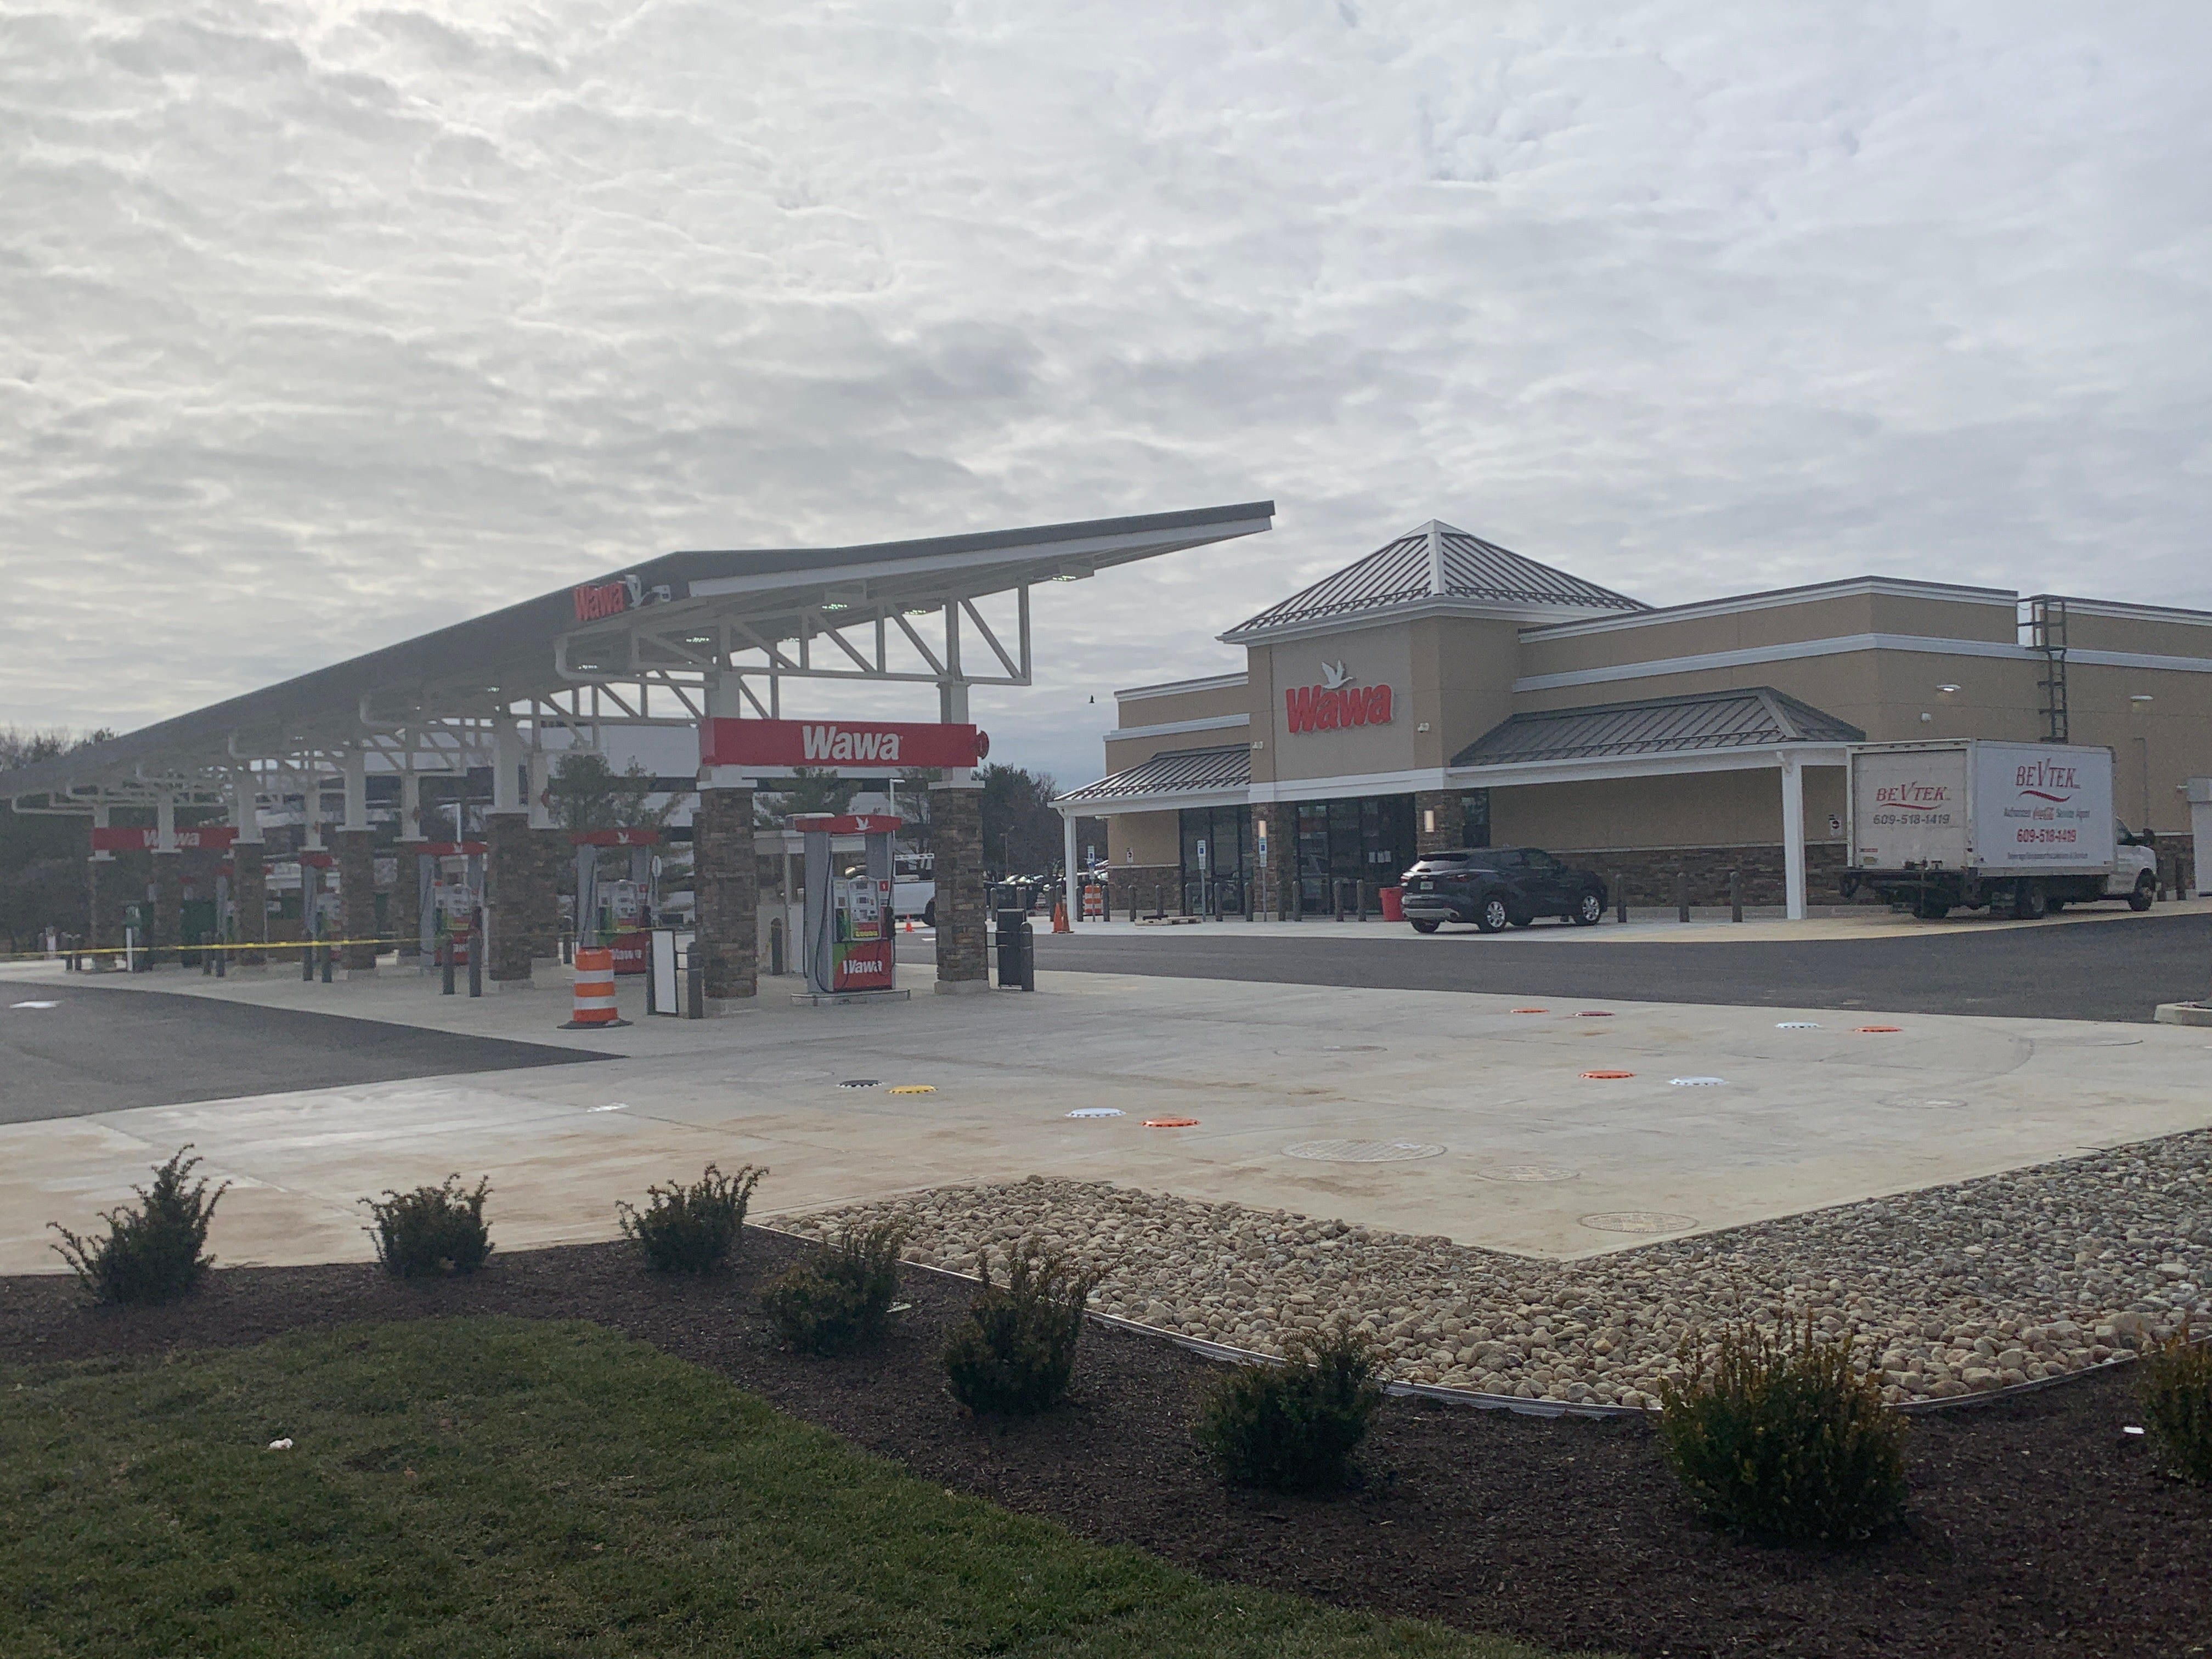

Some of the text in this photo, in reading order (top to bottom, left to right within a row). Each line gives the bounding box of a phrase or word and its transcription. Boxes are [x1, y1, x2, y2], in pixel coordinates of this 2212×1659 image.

[574, 581, 624, 621] Wawa
[1285, 684, 1392, 733] Wawa
[802, 725, 899, 760] Wawa
[1873, 814, 1951, 825] 609-518-1419
[143, 829, 200, 847] Wwa
[843, 959, 883, 974] Wawa
